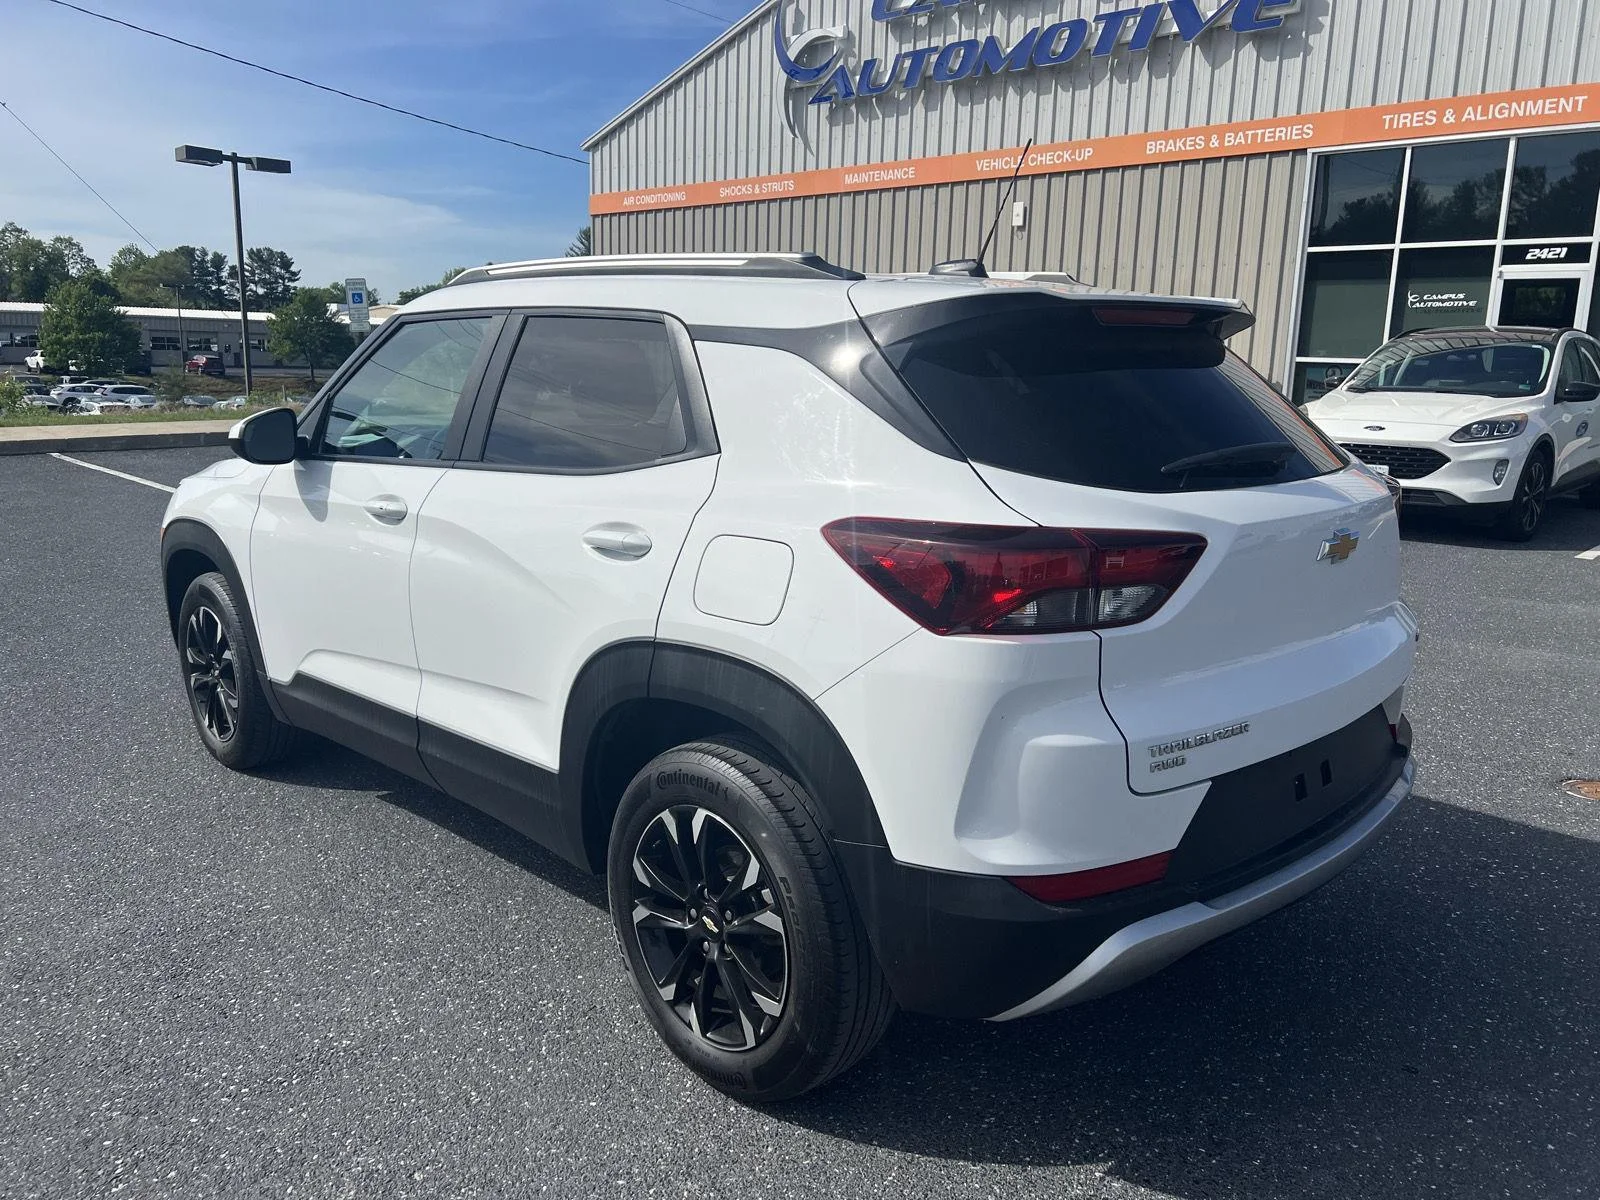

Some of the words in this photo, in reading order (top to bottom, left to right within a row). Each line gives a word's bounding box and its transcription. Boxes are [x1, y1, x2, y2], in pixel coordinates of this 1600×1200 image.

[808, 0, 1298, 105] AUTOMOTIVE
[1382, 109, 1437, 130] TIRES
[1442, 108, 1457, 124] &
[1461, 96, 1588, 122] ALIGNMENT
[1145, 136, 1205, 155] BRAKES
[1209, 134, 1220, 147] &
[1224, 123, 1314, 147] BATTERIES
[975, 155, 1025, 172] VEHICLE
[1027, 147, 1094, 167] CHECK-UP
[844, 167, 916, 185] MAINTENANCE
[623, 196, 635, 206] AIR
[635, 191, 686, 205] CONDITIONING
[719, 185, 752, 198] SHOCKS
[753, 184, 761, 194] &
[762, 180, 795, 193] STRUTS
[1525, 247, 1568, 260] 2421
[1411, 300, 1478, 308] AUTOMOTIVE
[656, 768, 721, 796] Continental
